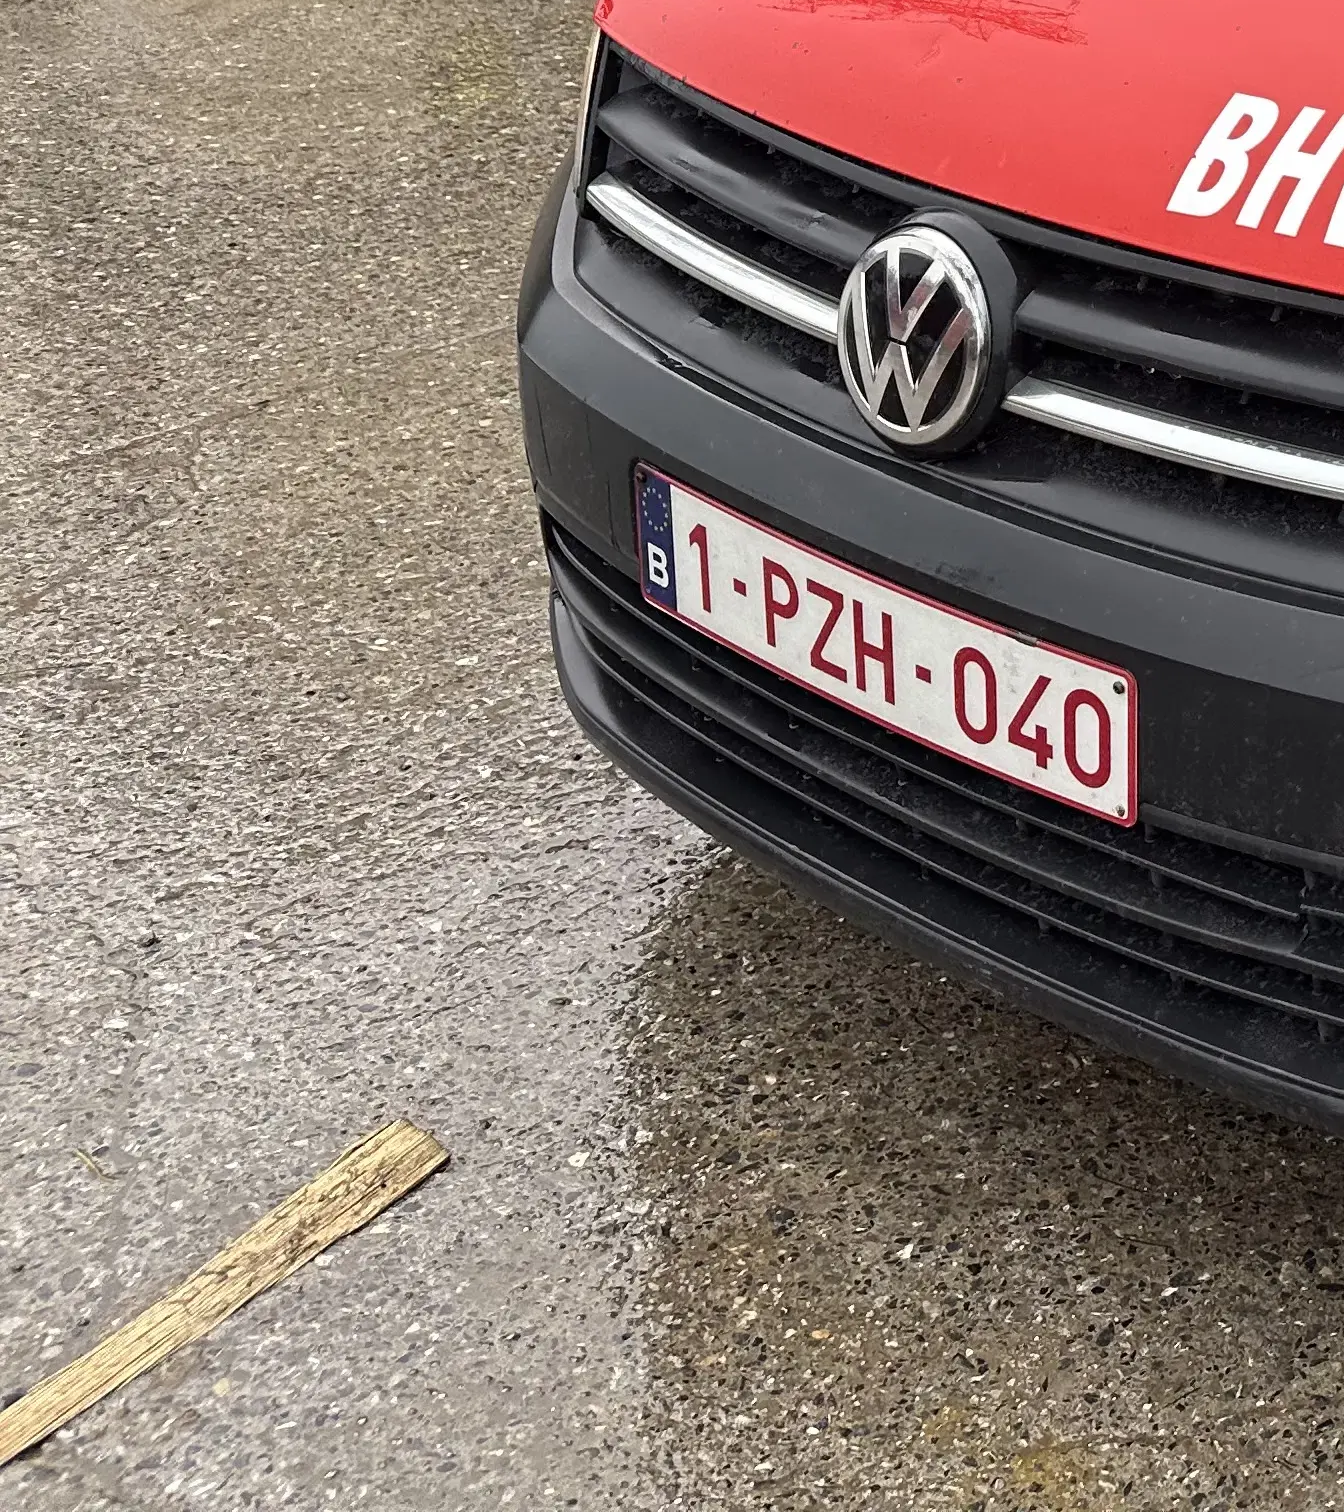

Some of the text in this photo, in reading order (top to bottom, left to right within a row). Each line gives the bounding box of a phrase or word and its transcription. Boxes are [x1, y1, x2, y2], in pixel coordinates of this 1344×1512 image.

[846, 236, 982, 438] VW
[646, 541, 671, 590] B
[687, 523, 1113, 790] 1-PZH-040
